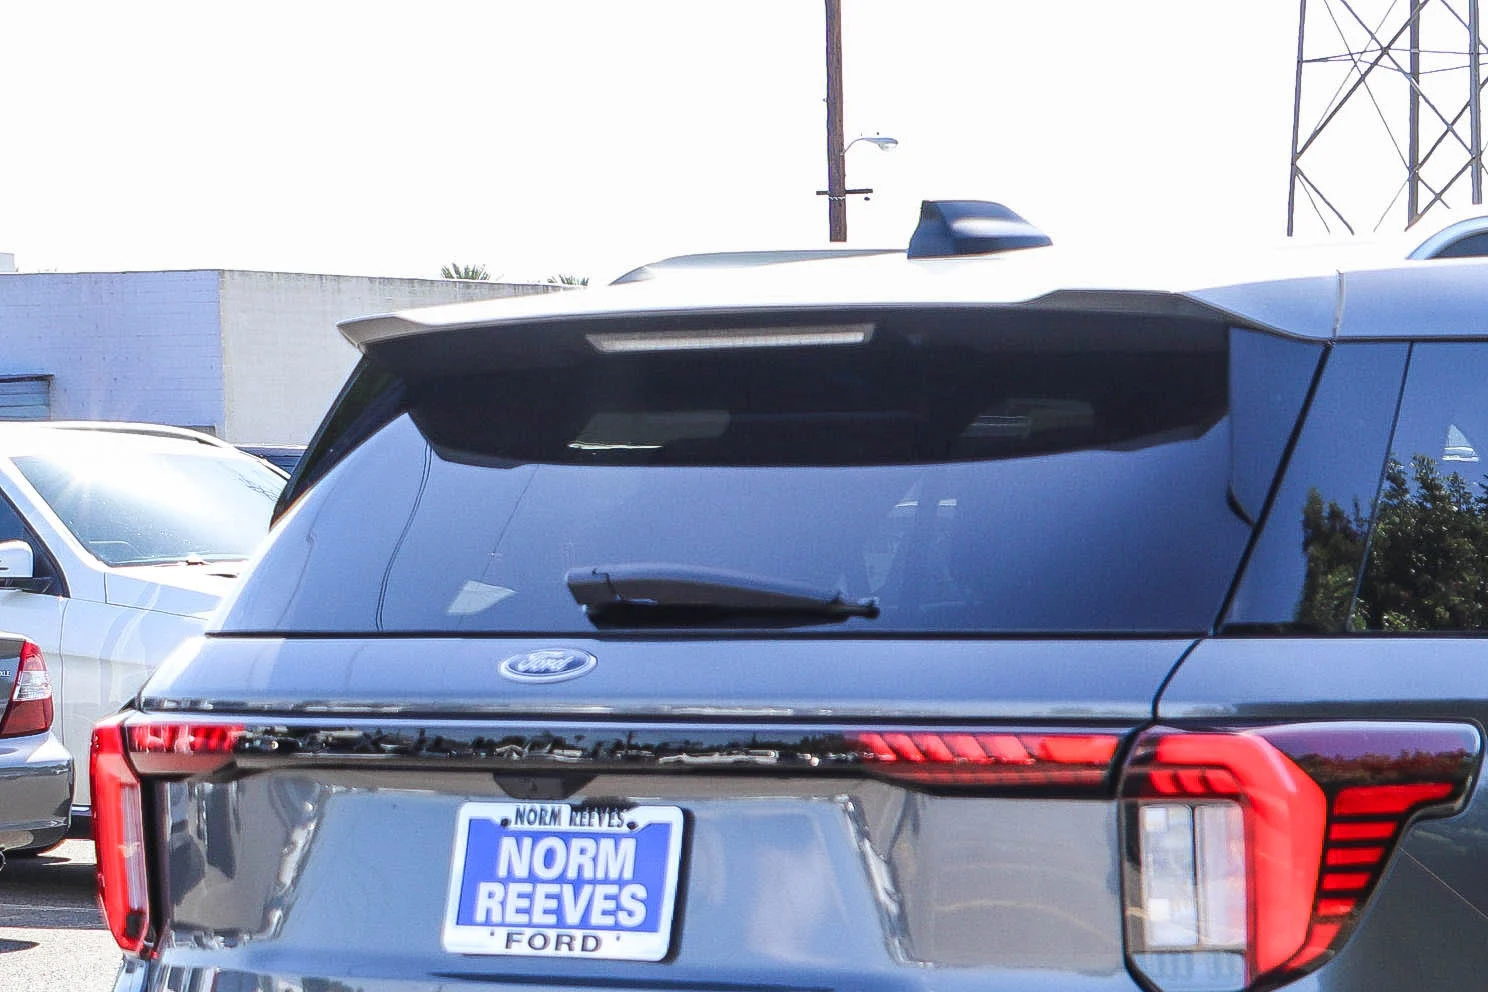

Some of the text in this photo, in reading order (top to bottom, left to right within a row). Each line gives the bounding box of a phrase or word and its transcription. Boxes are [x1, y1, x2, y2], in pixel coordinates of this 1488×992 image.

[514, 804, 625, 828] NORM REEVES
[498, 836, 637, 880] NORM
[474, 881, 648, 927] REEVES
[505, 932, 602, 952] FORD
